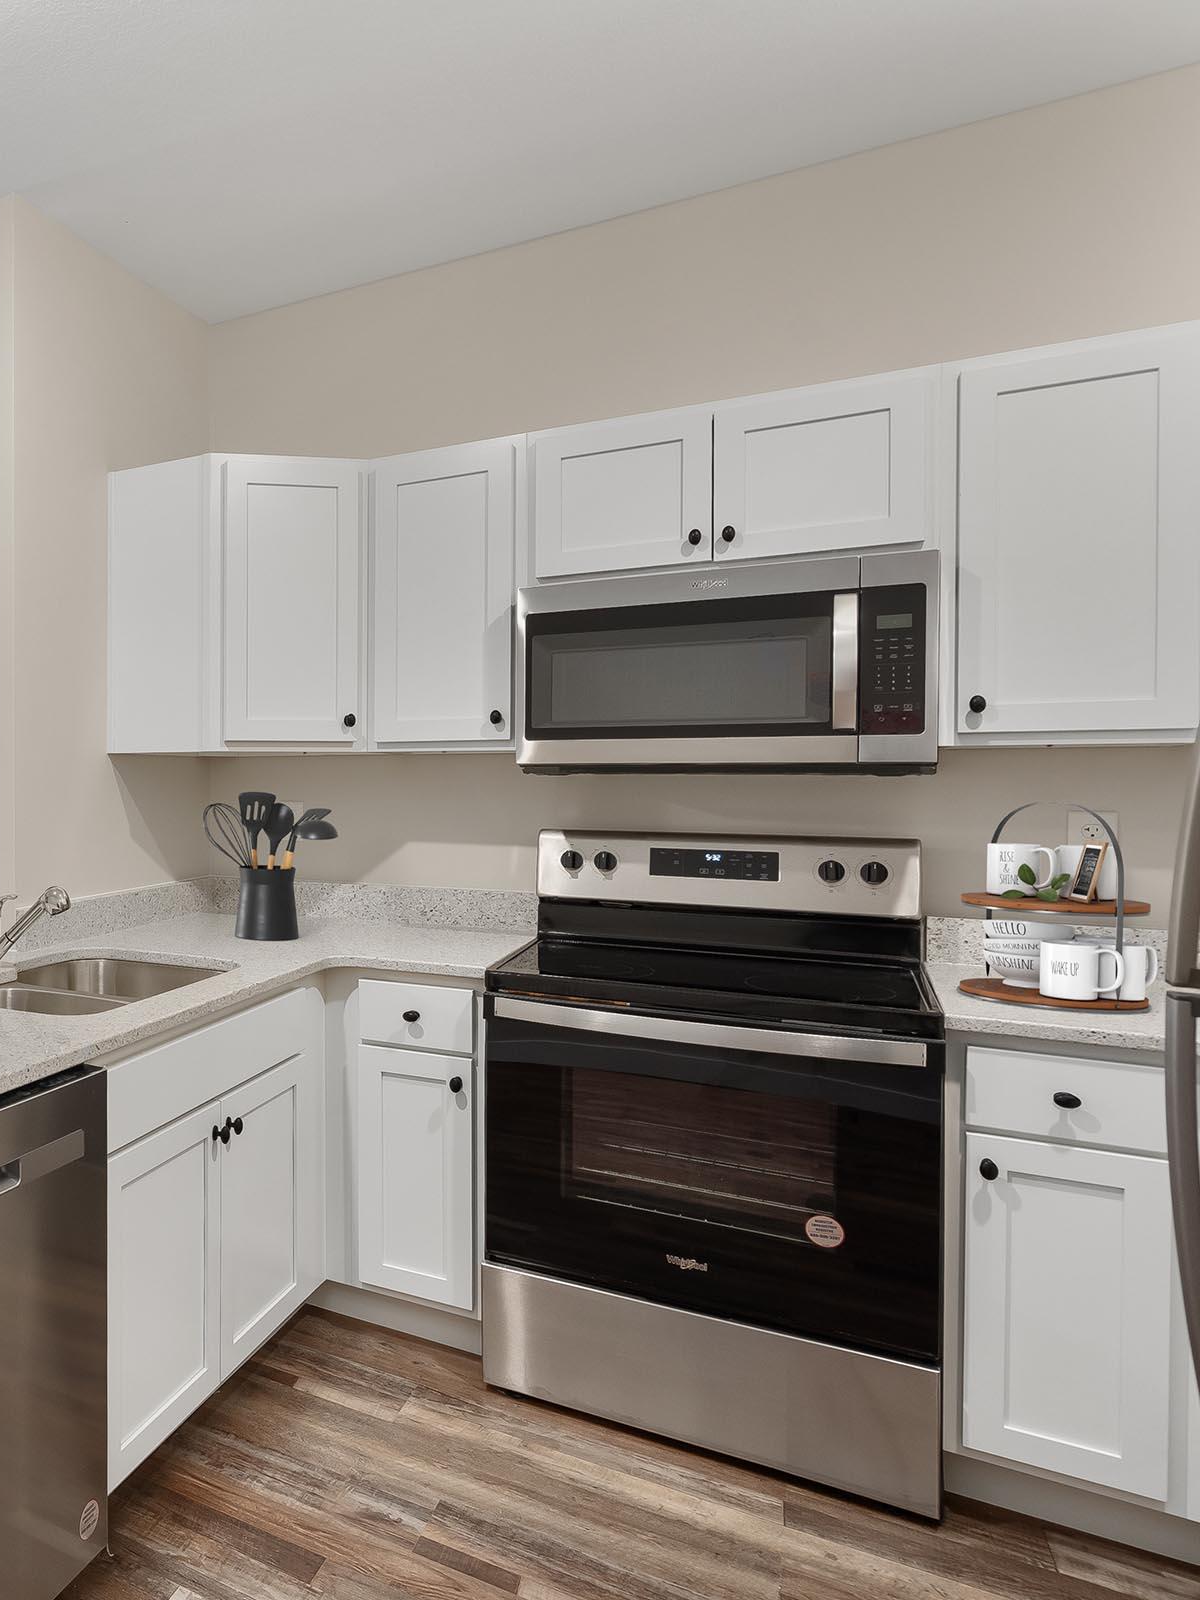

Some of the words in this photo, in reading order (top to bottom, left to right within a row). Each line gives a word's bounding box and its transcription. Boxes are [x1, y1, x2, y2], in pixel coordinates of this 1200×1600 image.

[1000, 850, 1014, 862] RISE
[1002, 863, 1010, 873] &
[992, 921, 1026, 936] HELLO
[990, 955, 1034, 970] SUNSHINE
[1051, 960, 1068, 976] WAKE
[1070, 962, 1080, 976] UP
[666, 1254, 707, 1271] Whirlpool
